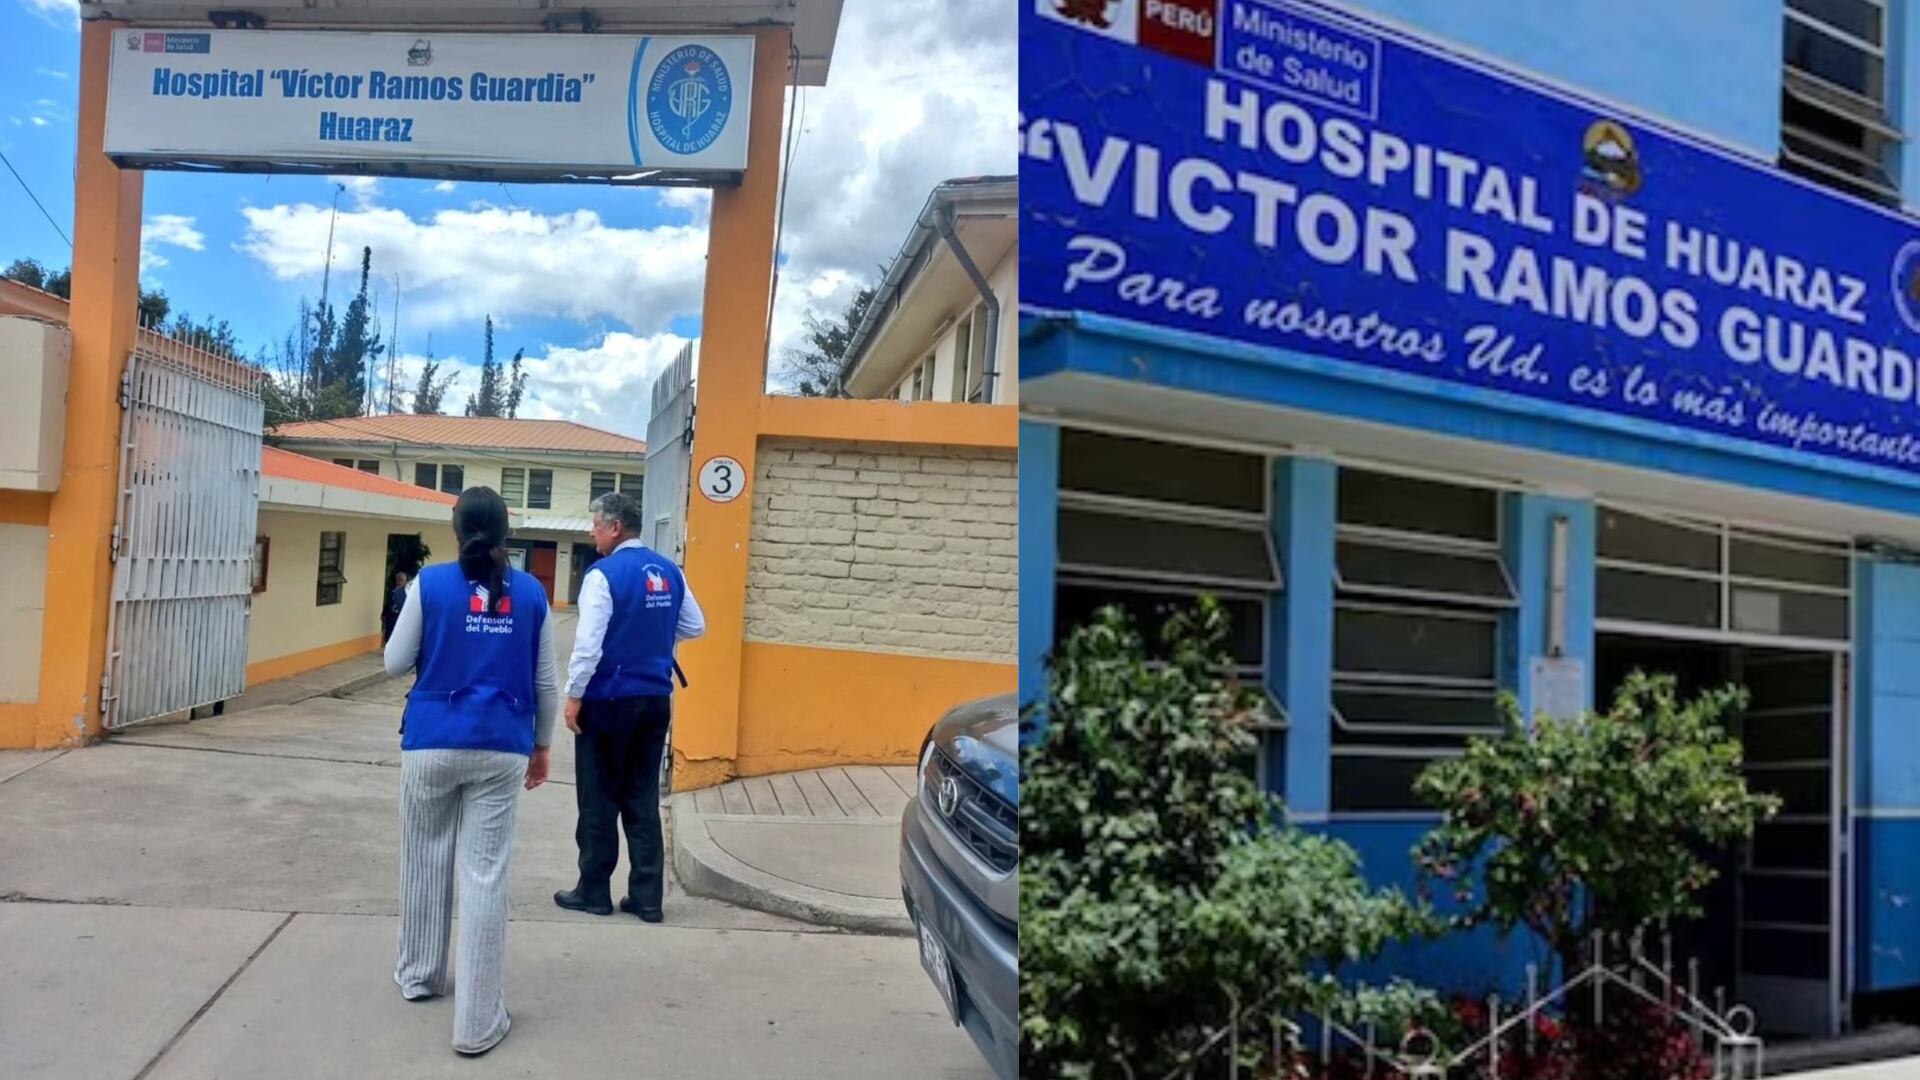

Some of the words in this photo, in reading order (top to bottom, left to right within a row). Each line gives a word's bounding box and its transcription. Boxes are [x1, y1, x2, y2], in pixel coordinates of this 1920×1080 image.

[1146, 0, 1213, 38] PERÚ
[1231, 2, 1368, 71] Ministerio
[153, 67, 264, 99] Hospital
[270, 68, 363, 98] “Víctor
[368, 71, 464, 101] Ramos
[470, 72, 596, 103] Guardia”
[651, 48, 696, 92] MINISTERIO
[699, 49, 713, 64] DE
[710, 60, 728, 92] SALUD
[1235, 45, 1274, 77] de
[1282, 57, 1361, 104] Salud
[319, 111, 413, 142] Huaraz
[650, 111, 682, 153] HOSPITAL
[682, 141, 698, 153] DE
[696, 111, 727, 148] HUARAZ
[1204, 79, 1554, 234] HOSPITAL
[1573, 191, 1647, 261] DE
[1666, 220, 1868, 325] HUARAZ
[1444, 227, 1699, 349] RAMOS
[1063, 235, 1222, 320] Para
[1243, 297, 1446, 363] nosotros
[1464, 325, 1550, 384] Ud.
[1568, 362, 1611, 398] es
[1623, 364, 1659, 407] lo
[712, 465, 731, 494] 3
[465, 623, 481, 633] del
[482, 624, 513, 634] Pueblo
